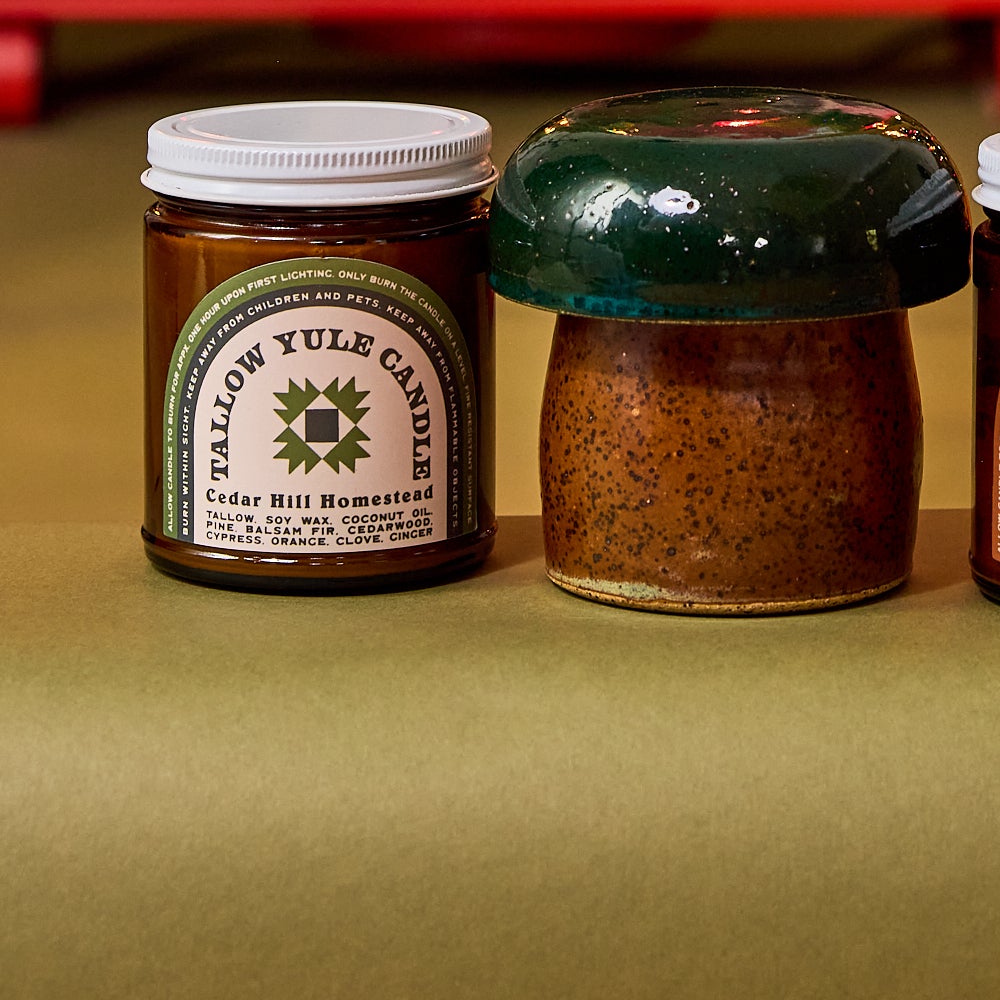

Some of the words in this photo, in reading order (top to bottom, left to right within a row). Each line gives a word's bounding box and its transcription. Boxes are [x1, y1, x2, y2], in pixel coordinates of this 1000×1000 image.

[247, 275, 277, 292] FIRST
[338, 270, 367, 281] ONLY
[369, 275, 398, 291] BURN
[220, 286, 246, 306] UPON
[400, 285, 418, 301] THE
[199, 302, 221, 326] HOUR
[418, 297, 446, 328] CANDLE
[187, 323, 202, 343] ONE
[444, 327, 454, 340] ON
[451, 341, 457, 349] A
[171, 371, 180, 393] FOR
[186, 367, 199, 400] KEEP
[198, 337, 217, 366] AWAY
[216, 313, 245, 338] FROM
[247, 292, 309, 316] CHILDREN
[315, 292, 341, 300] AND
[386, 305, 415, 324] KEEP
[415, 325, 437, 349] AWAY
[436, 351, 451, 382] FROM
[448, 386, 458, 462] FLAMMABLE
[168, 395, 176, 425] BURN
[210, 342, 266, 481] TALLOW
[272, 328, 375, 358] YULE
[379, 348, 431, 481] CANDLE
[168, 427, 173, 442] TO
[206, 488, 262, 507] Cedar
[270, 493, 311, 509] Hill
[320, 484, 433, 509] Homestead
[265, 515, 292, 525] SOY
[341, 511, 404, 524] COCONUT
[245, 525, 302, 535] BALSAM
[389, 527, 433, 542] GINGER
